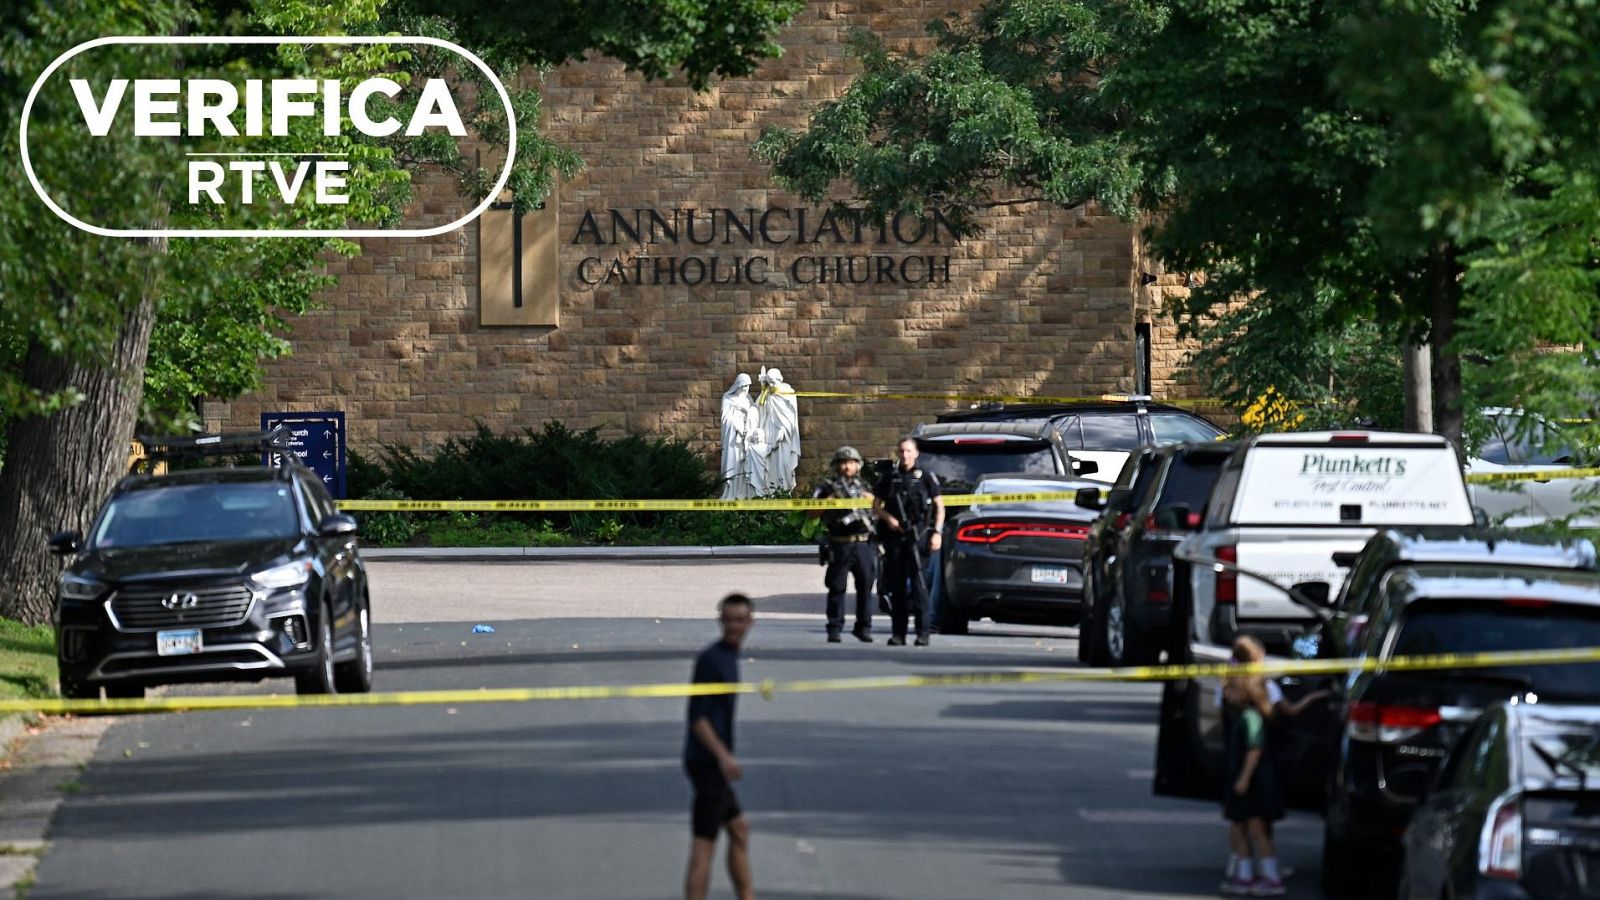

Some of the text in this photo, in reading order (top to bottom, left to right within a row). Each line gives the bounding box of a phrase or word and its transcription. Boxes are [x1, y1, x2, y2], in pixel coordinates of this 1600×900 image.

[572, 206, 963, 245] ANNUNCIATION
[577, 255, 952, 285] CATHOLIC CHURCH
[1299, 453, 1408, 477] Plunkett's
